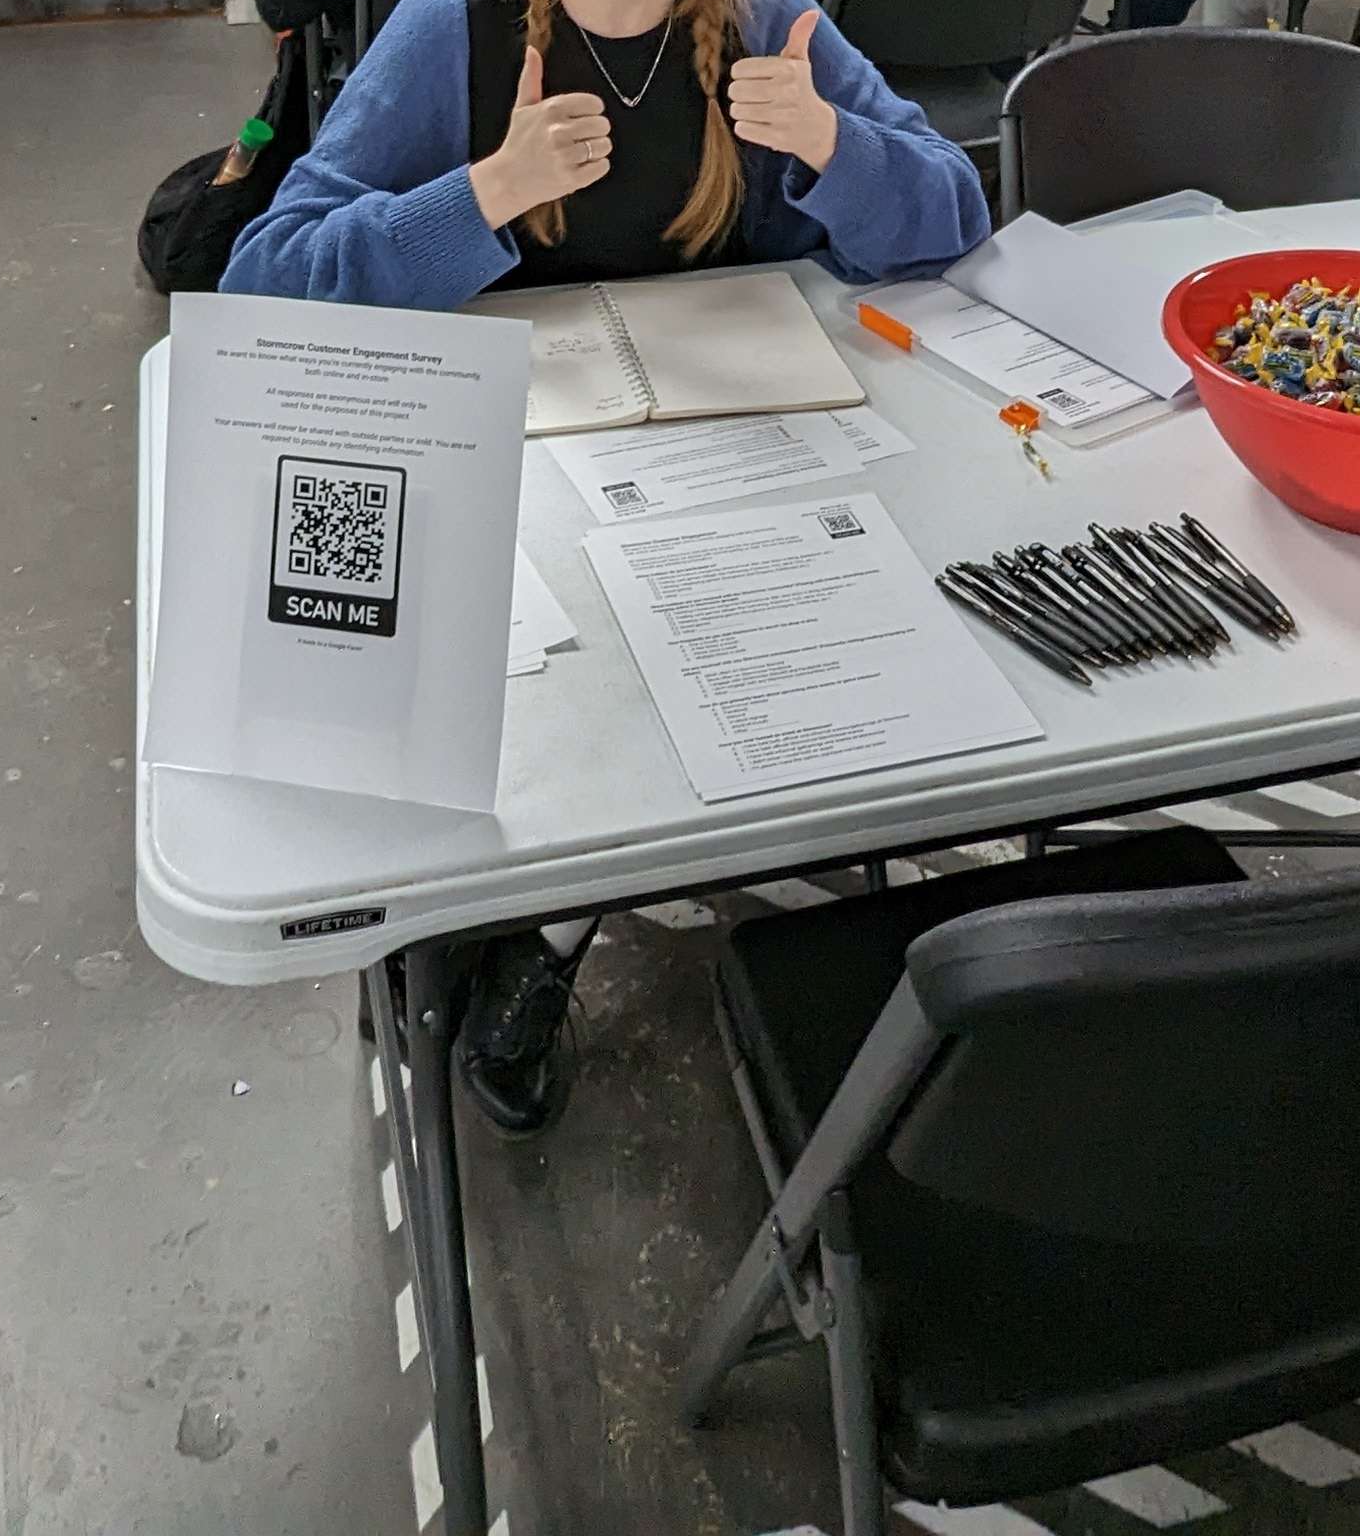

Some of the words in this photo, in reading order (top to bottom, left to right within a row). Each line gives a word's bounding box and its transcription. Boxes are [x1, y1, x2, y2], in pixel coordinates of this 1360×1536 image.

[229, 350, 248, 360] want
[258, 351, 278, 362] know
[279, 353, 298, 363] what
[298, 356, 317, 366] ways
[256, 337, 306, 352] Stormcrow
[307, 343, 351, 356] Customer
[353, 346, 410, 361] Engagement
[411, 352, 443, 365] Survey
[305, 367, 321, 376] both
[322, 369, 345, 379] online
[346, 371, 360, 380] and
[265, 387, 276, 396] All
[372, 398, 386, 407] and
[401, 400, 417, 410] only
[417, 402, 428, 410] be
[281, 401, 299, 410] used
[300, 402, 311, 411] for
[311, 403, 323, 412] the
[324, 404, 358, 415] purposes
[369, 407, 382, 417] this
[301, 437, 328, 447] provide
[285, 595, 343, 622] SCAN
[347, 603, 381, 627] ME
[294, 912, 374, 935] LIFETIME
